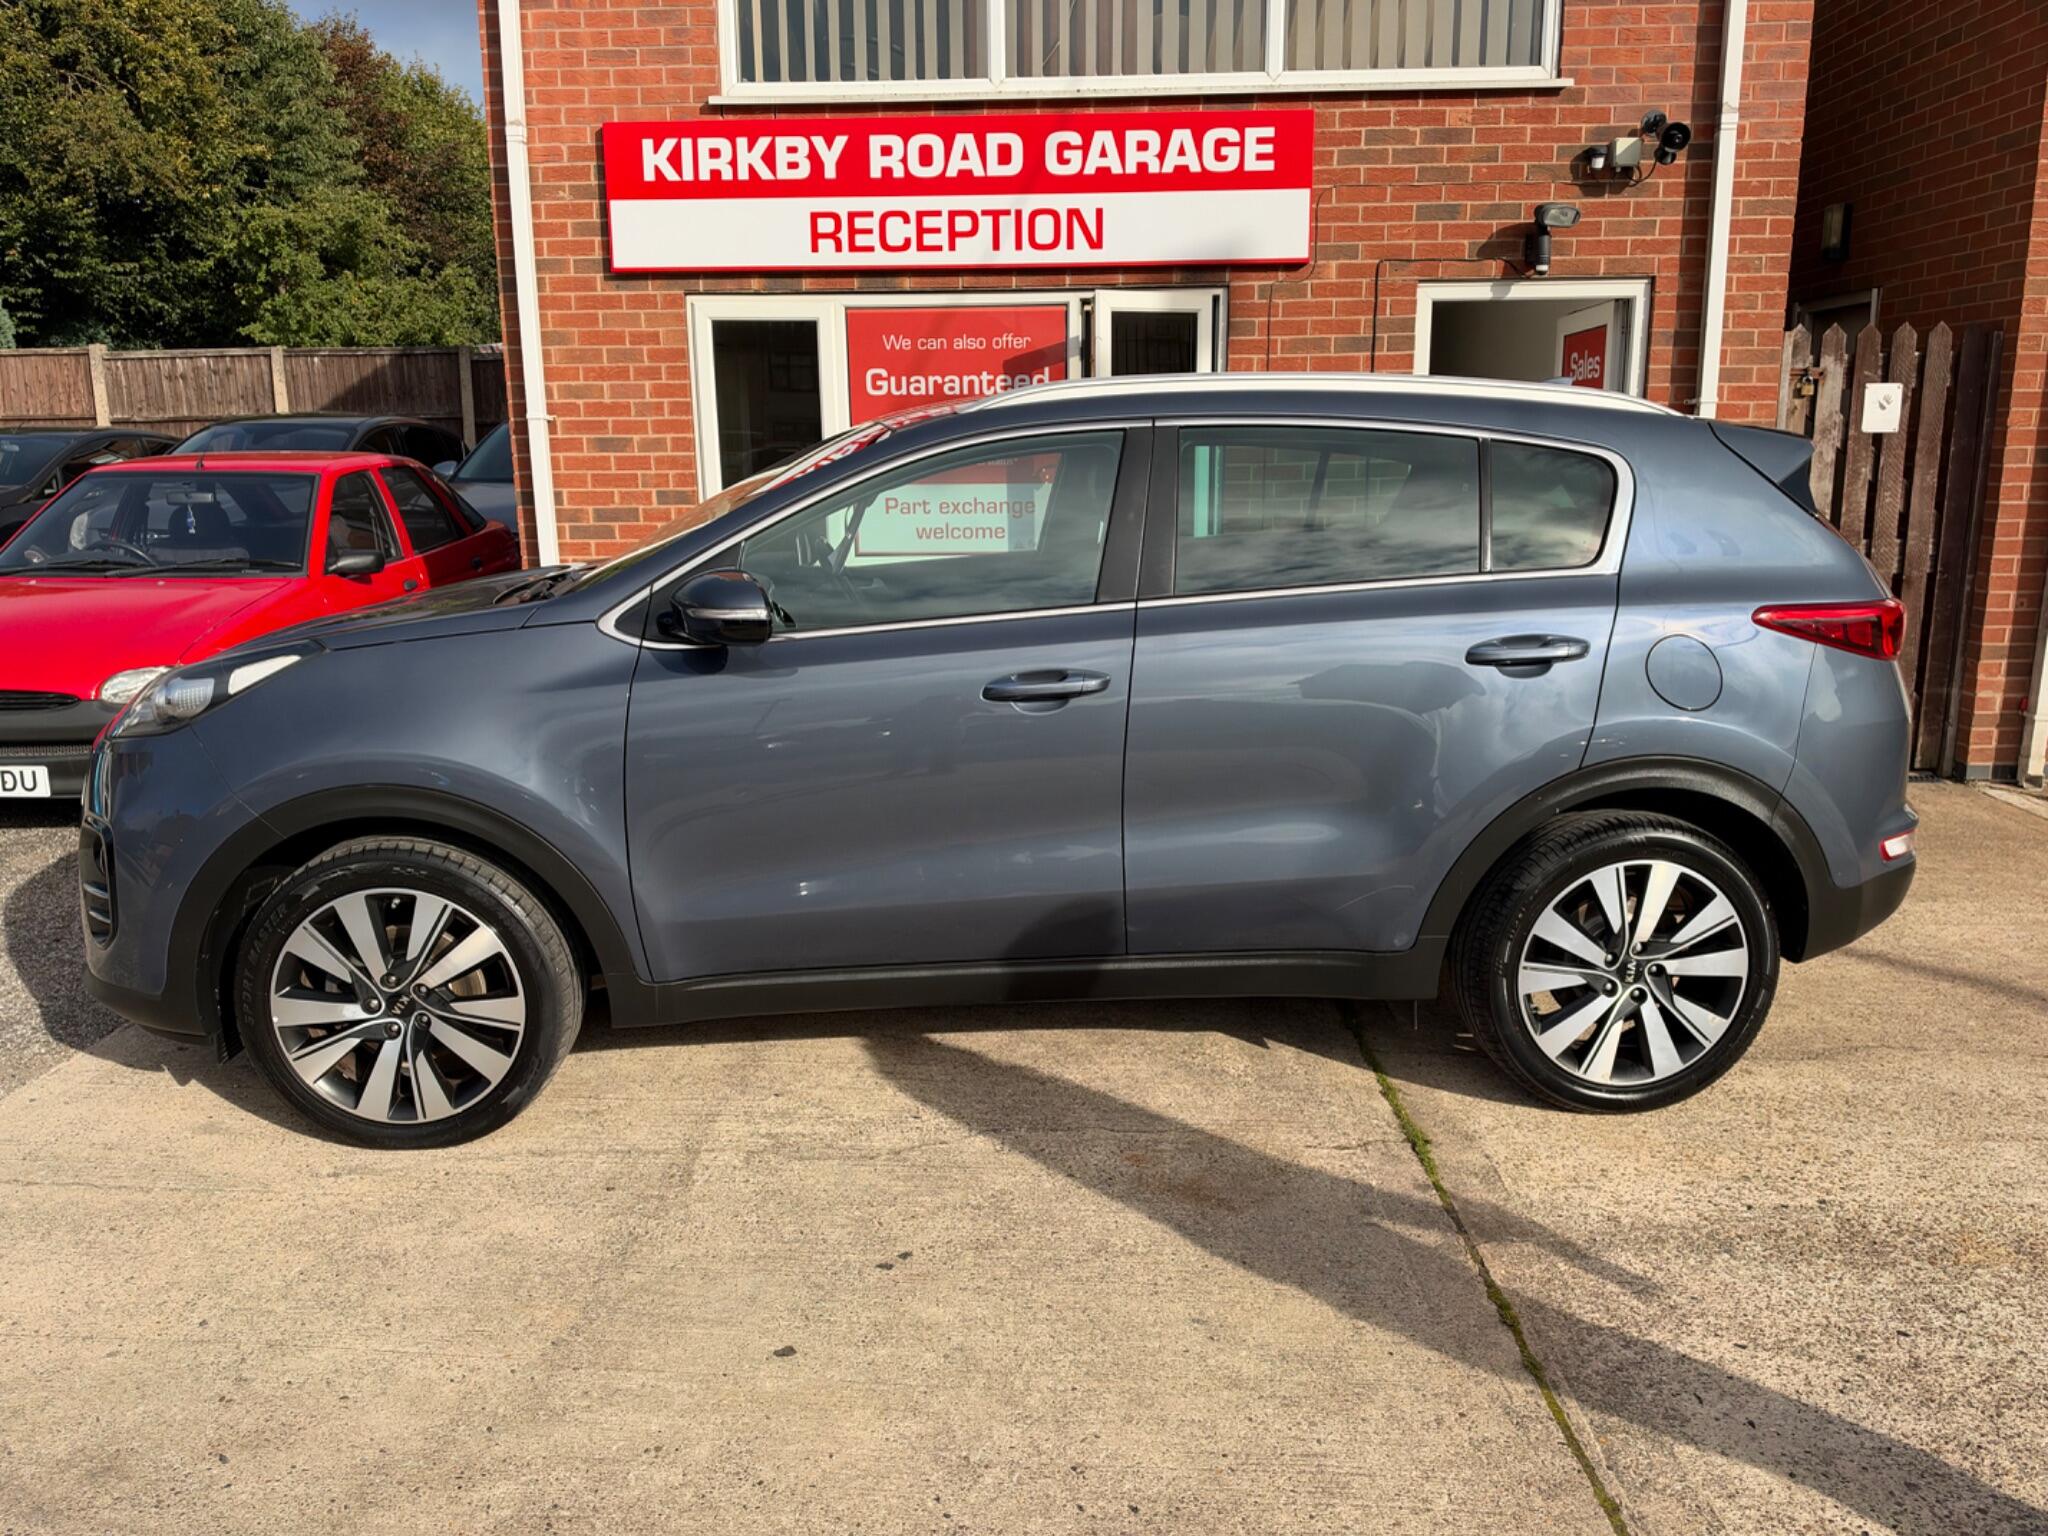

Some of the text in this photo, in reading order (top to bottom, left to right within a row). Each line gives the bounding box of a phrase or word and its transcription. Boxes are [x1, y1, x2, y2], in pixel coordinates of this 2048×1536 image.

[641, 126, 1276, 182] KIRKBY ROAD GARAGE
[809, 207, 1104, 253] RECEPTION
[882, 332, 1032, 351] We can also offer
[1570, 350, 1601, 381] Sales
[865, 366, 1050, 396] Guaranteed
[884, 497, 1036, 518] Part exchange
[916, 522, 1006, 540] welcome
[0, 770, 37, 792] DU
[1624, 959, 1637, 983] KIA
[390, 994, 410, 1015] KIA
